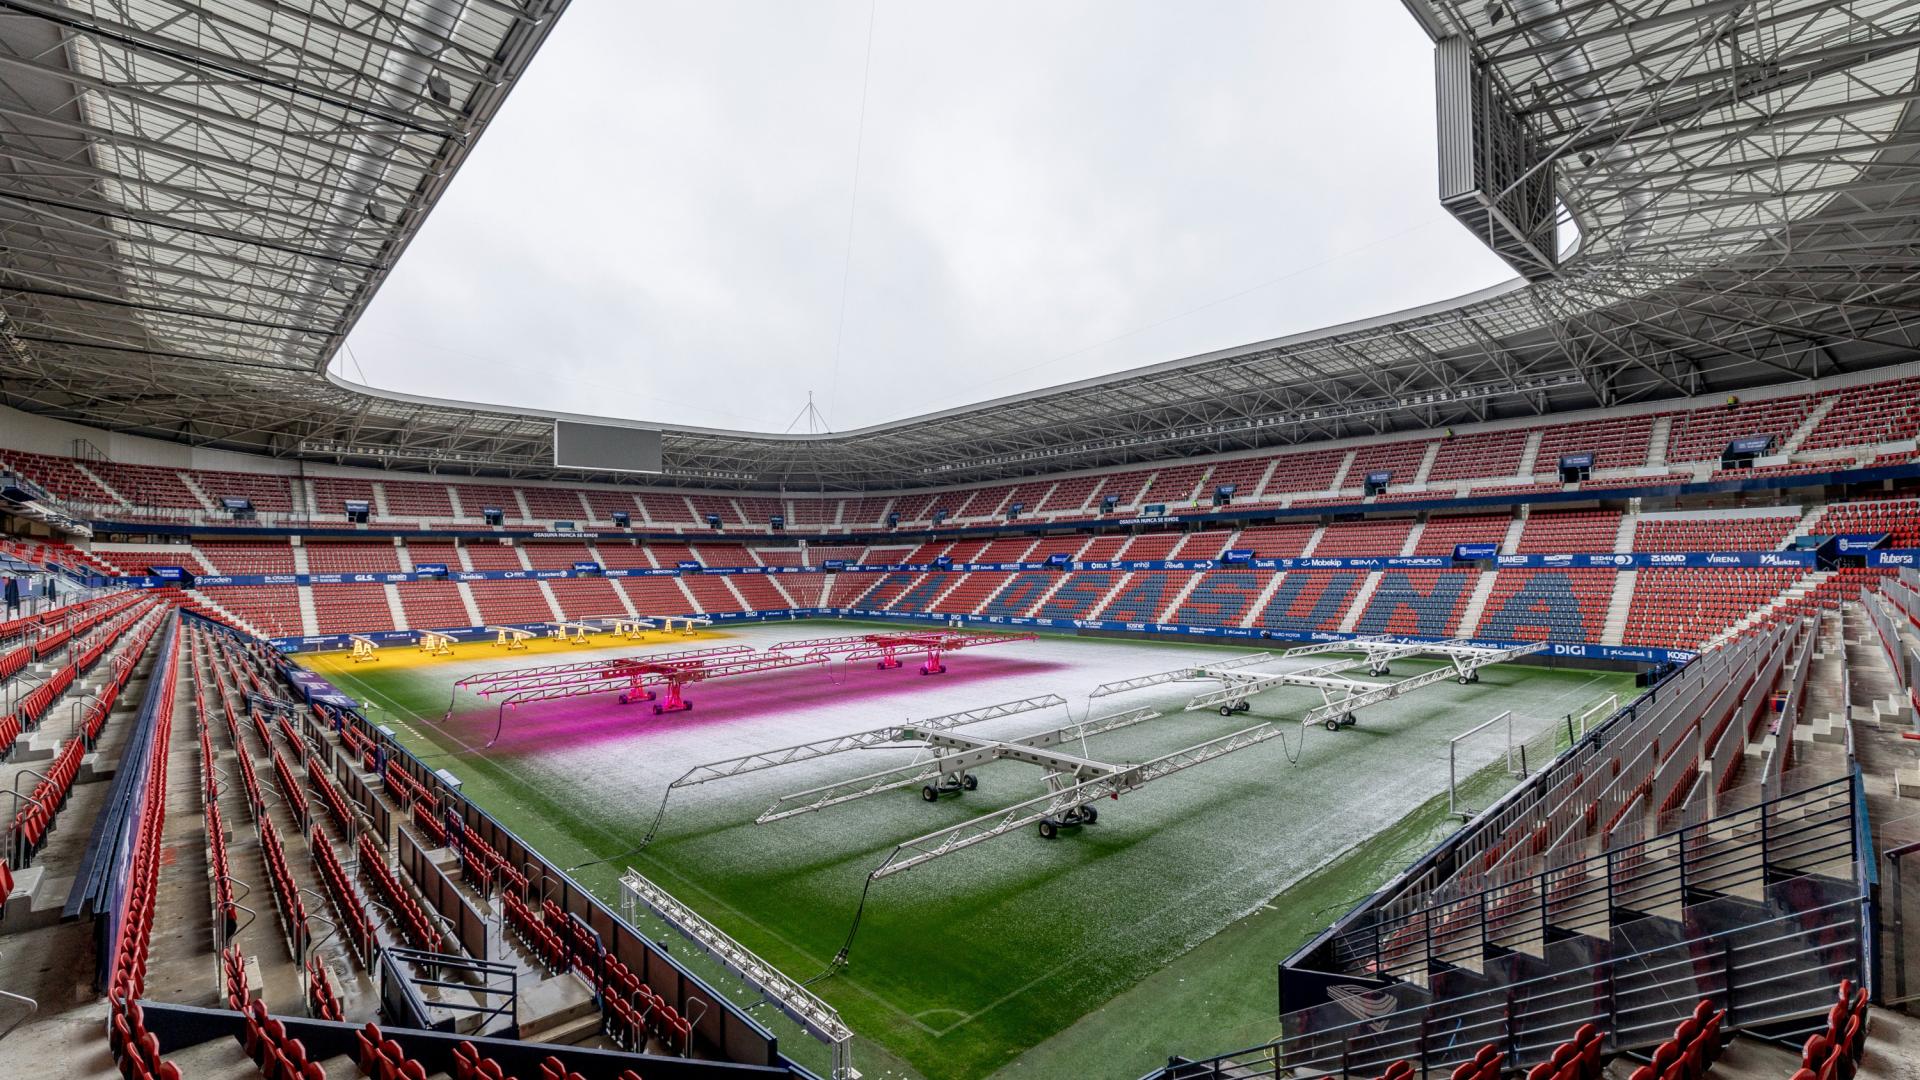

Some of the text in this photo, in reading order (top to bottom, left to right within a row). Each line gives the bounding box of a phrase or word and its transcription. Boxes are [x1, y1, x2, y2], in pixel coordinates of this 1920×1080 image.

[1311, 559, 1342, 567] Mobekip
[1706, 554, 1740, 563] VIRENA
[1879, 552, 1913, 564] Rubersa
[1555, 645, 1586, 656] DIGI
